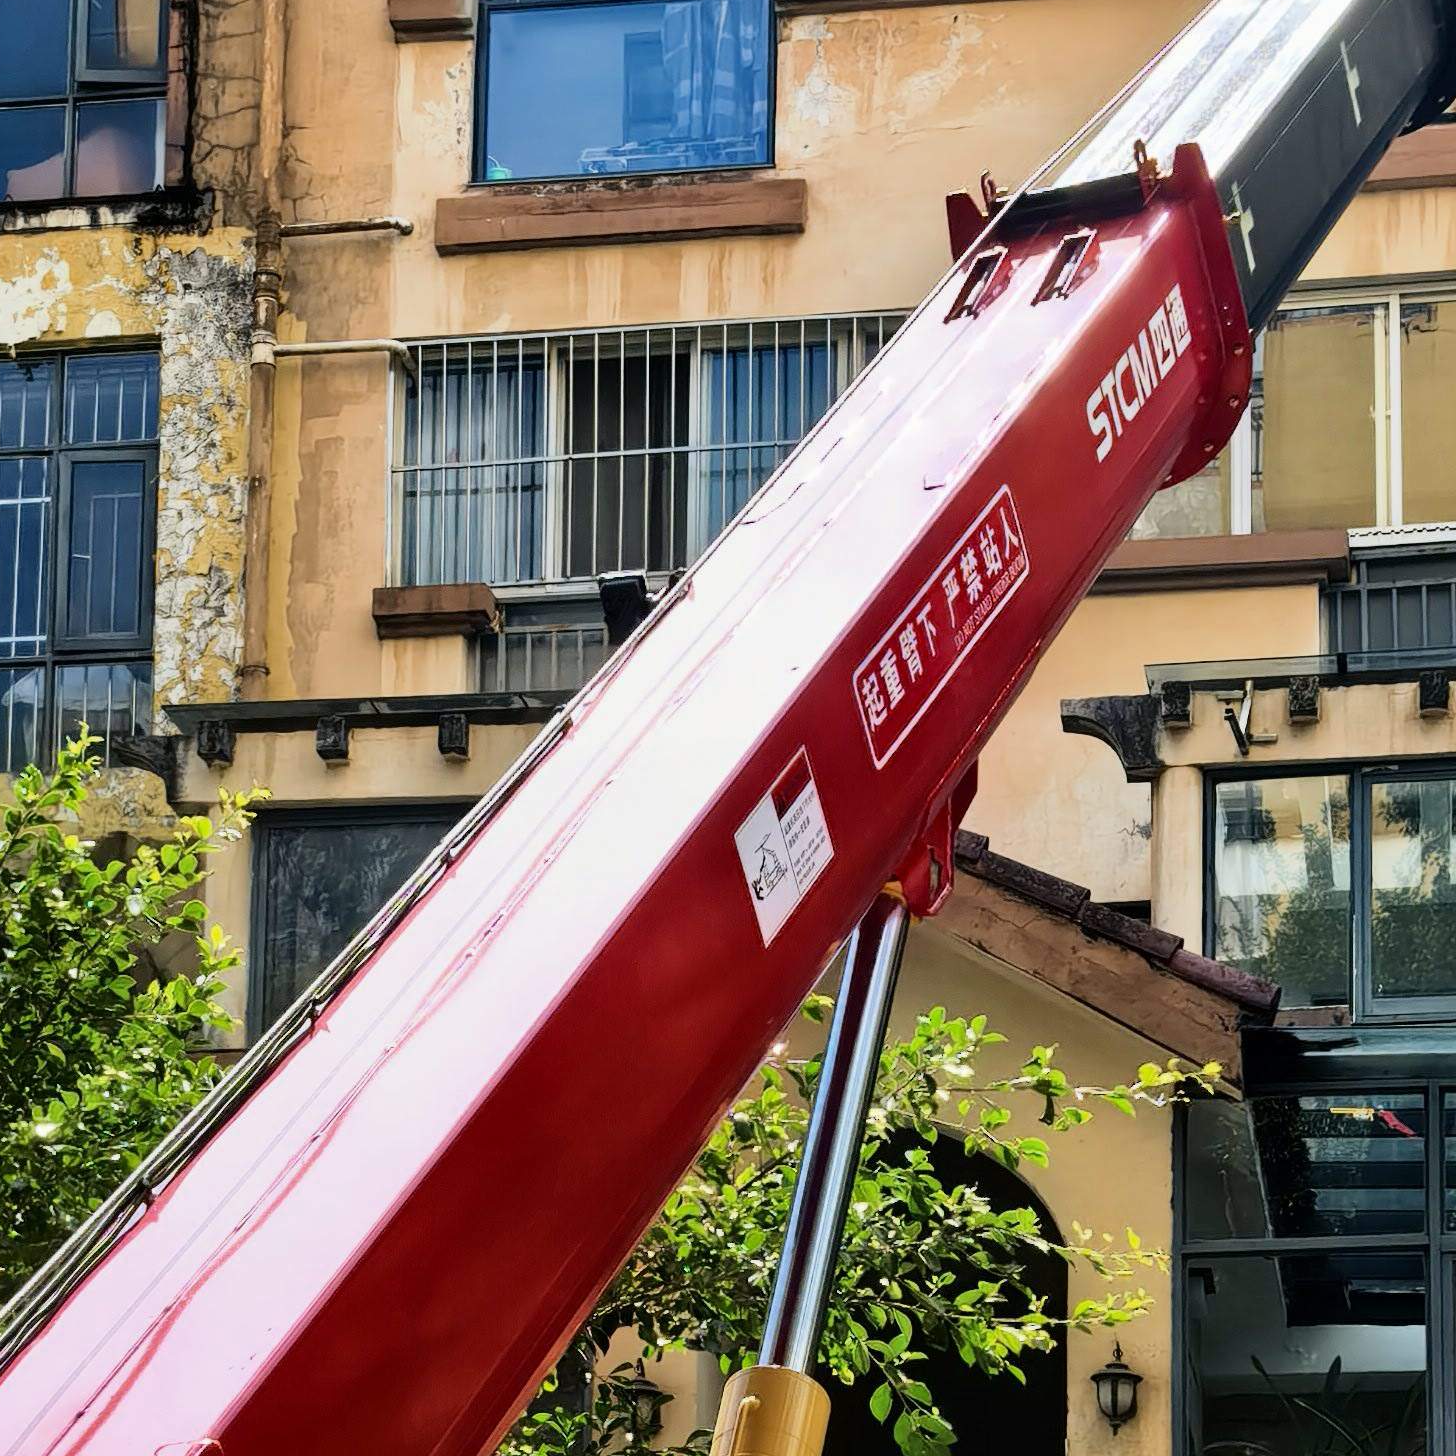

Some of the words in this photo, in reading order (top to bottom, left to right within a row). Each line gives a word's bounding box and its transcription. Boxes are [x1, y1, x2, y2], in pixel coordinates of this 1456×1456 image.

[862, 602, 937, 732] 起重臂下
[942, 506, 1020, 629] 严禁站人
